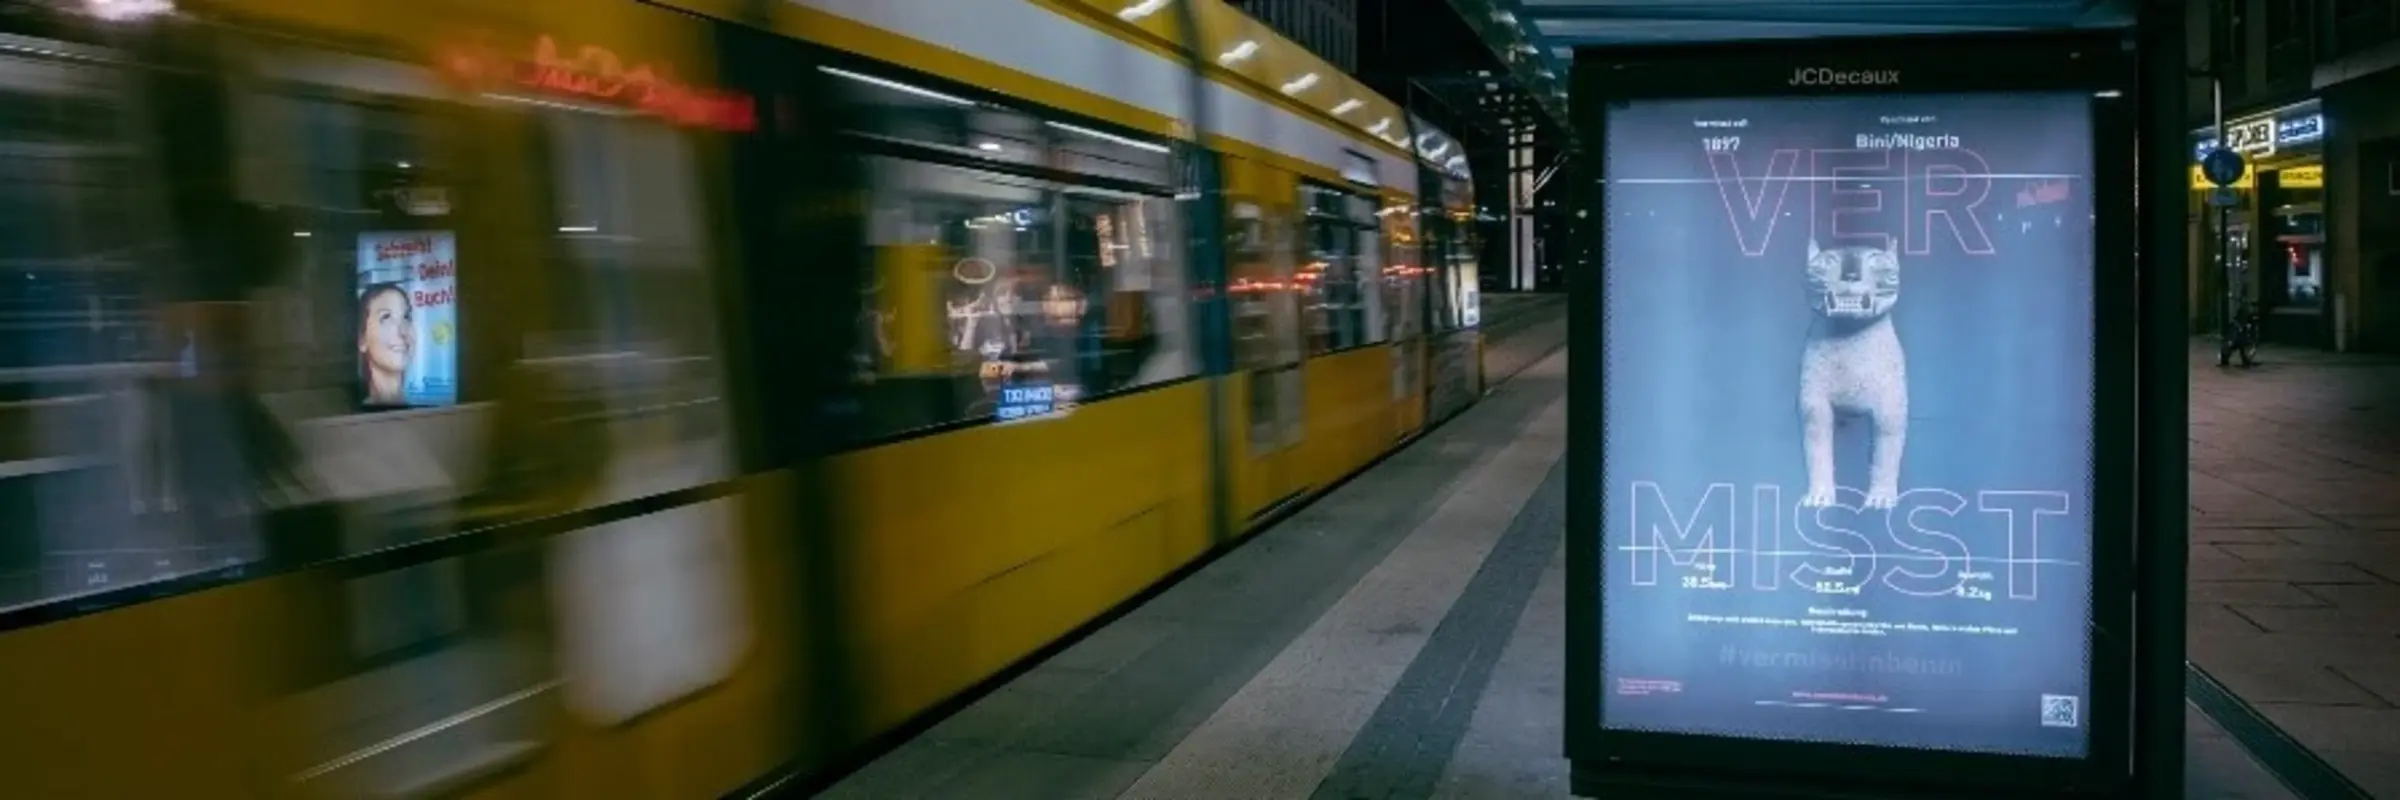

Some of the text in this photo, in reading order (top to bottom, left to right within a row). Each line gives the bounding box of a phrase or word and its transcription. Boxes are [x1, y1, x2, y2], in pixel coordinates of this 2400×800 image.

[1788, 66, 1901, 86] JCDecaux
[1707, 147, 1996, 256] VER
[1629, 480, 2070, 601] MISST
